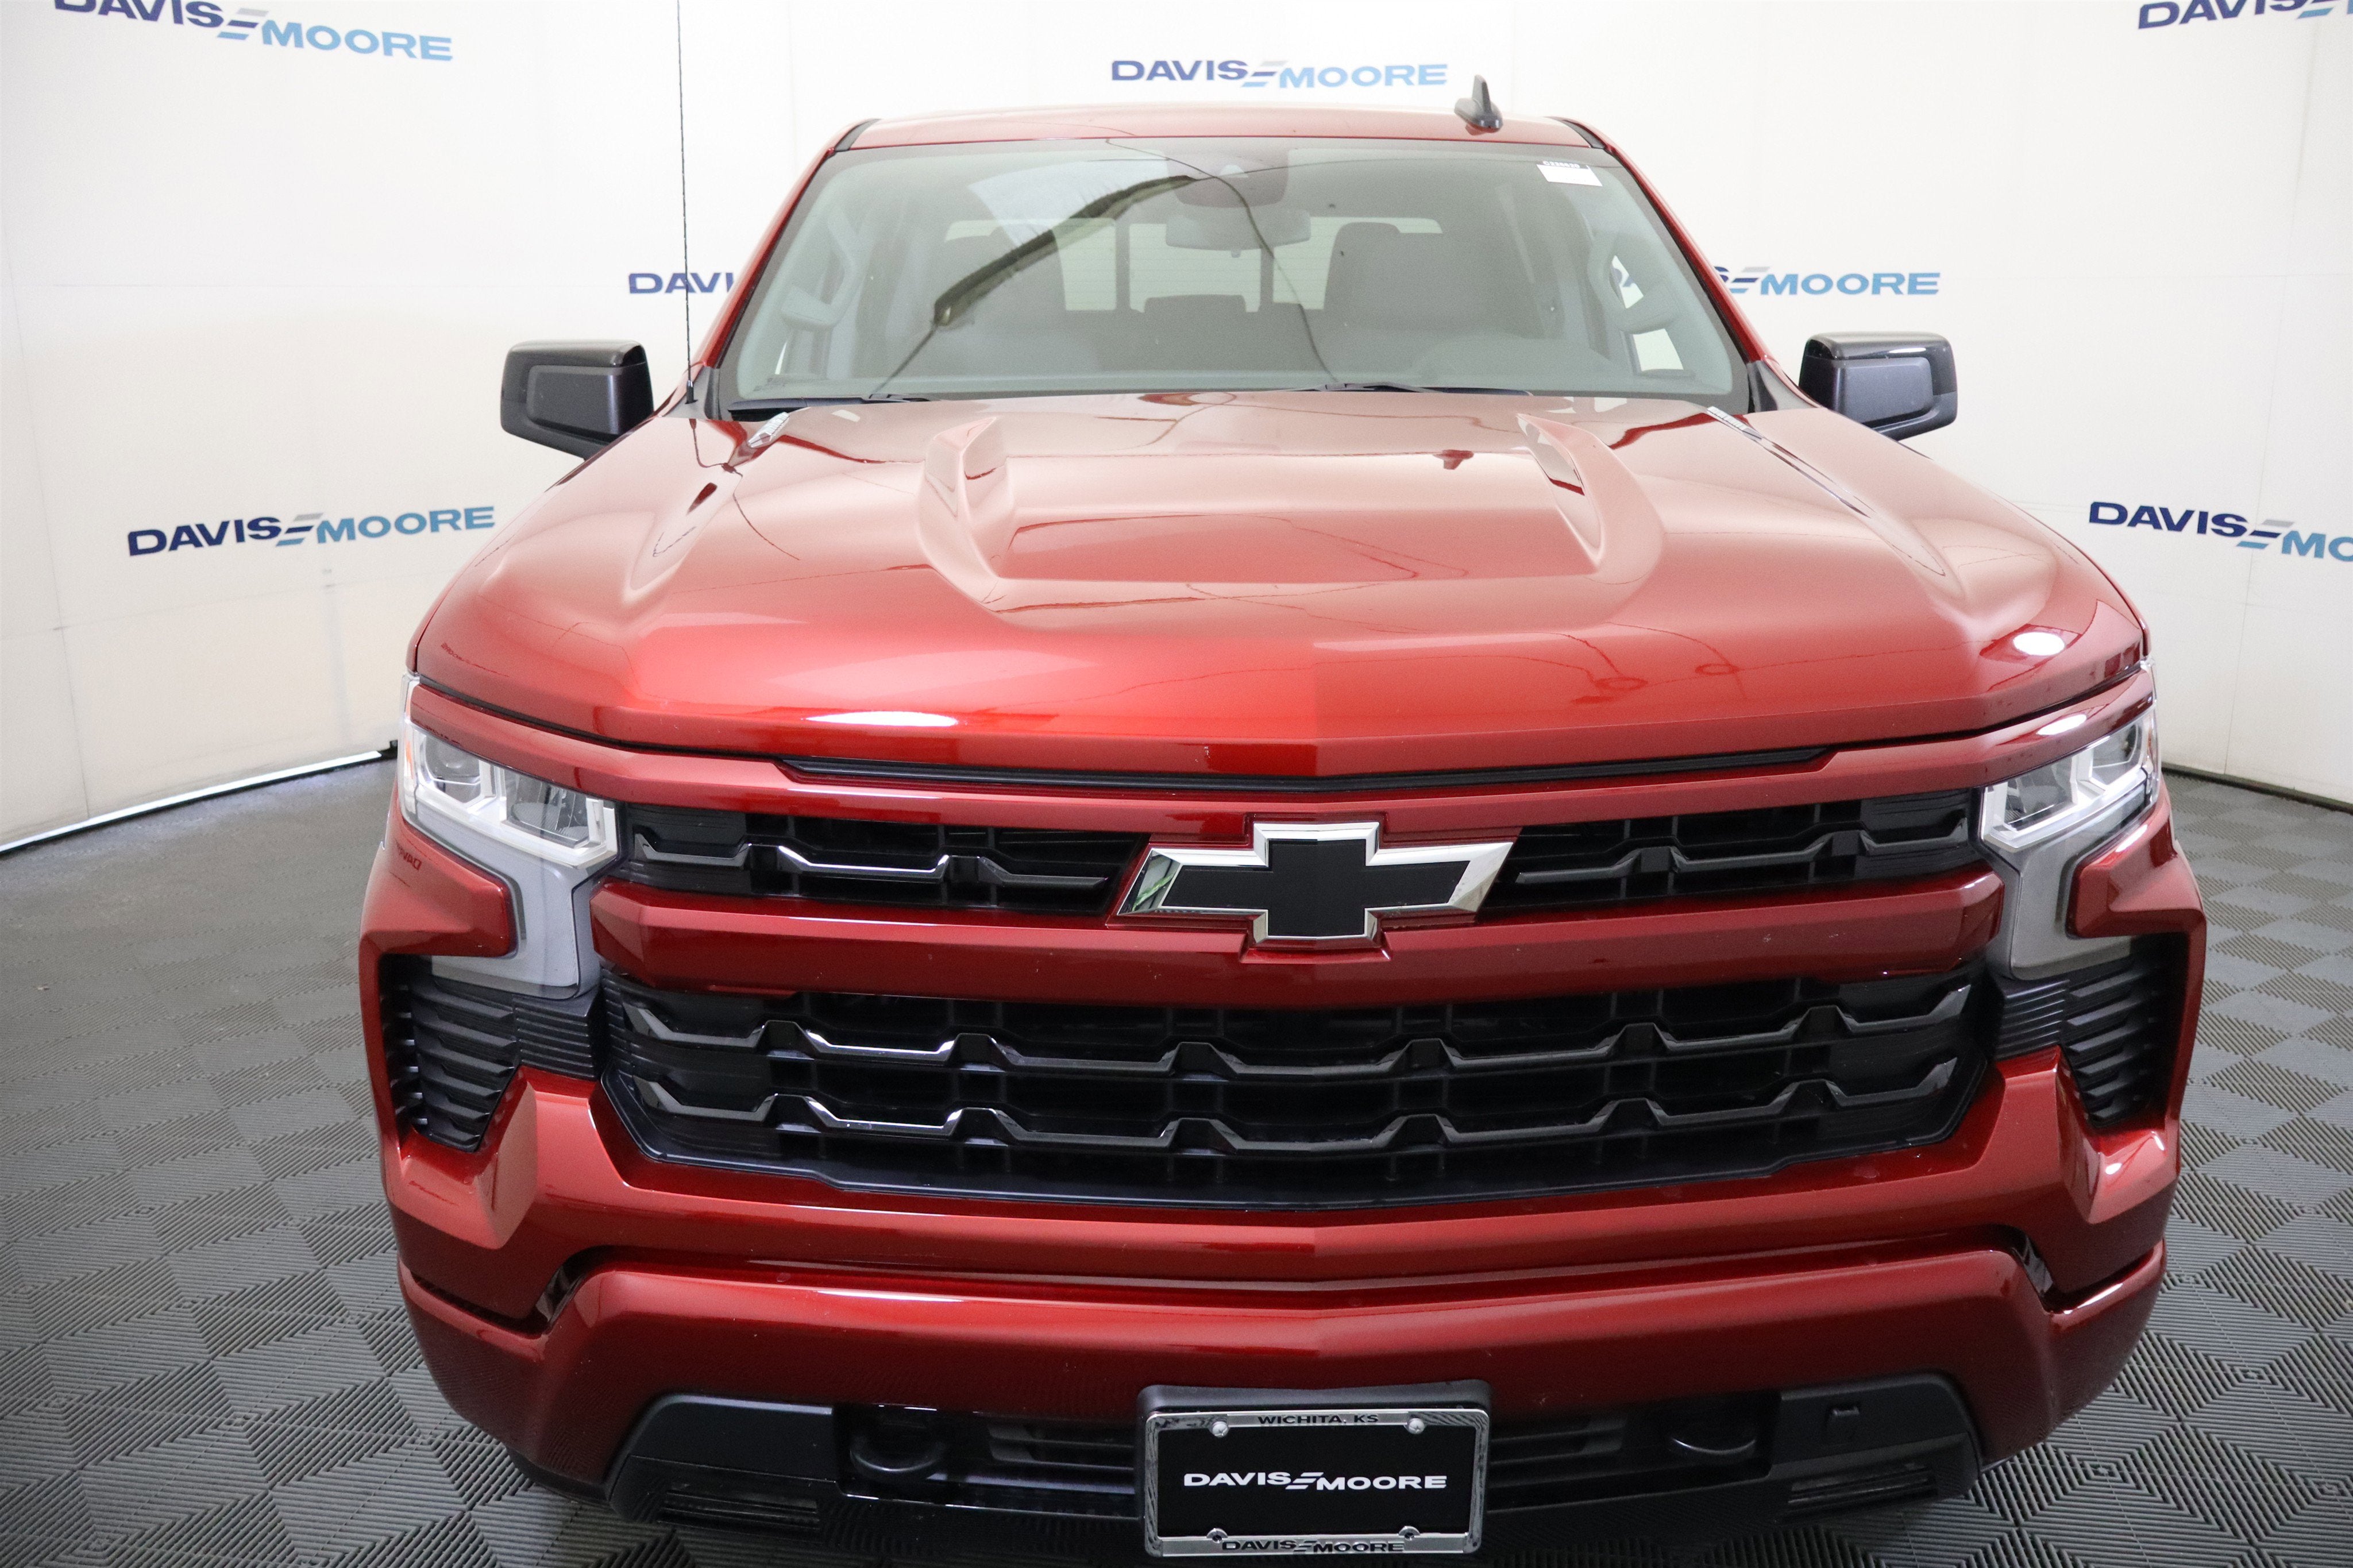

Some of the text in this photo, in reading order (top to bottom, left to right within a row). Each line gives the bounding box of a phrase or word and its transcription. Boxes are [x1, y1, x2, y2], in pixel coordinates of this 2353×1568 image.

[261, 20, 453, 61] MOORE
[1111, 60, 1448, 88] DAVIS MOORE
[1760, 272, 1941, 296] MOORE
[126, 505, 496, 558] DAVIS MOORE
[2088, 501, 2248, 539] DAVIS
[1353, 1415, 1379, 1423] KS
[1184, 1472, 1447, 1490] DAVIS MOORE
[1222, 1540, 1405, 1554] DAVIS MOORE
